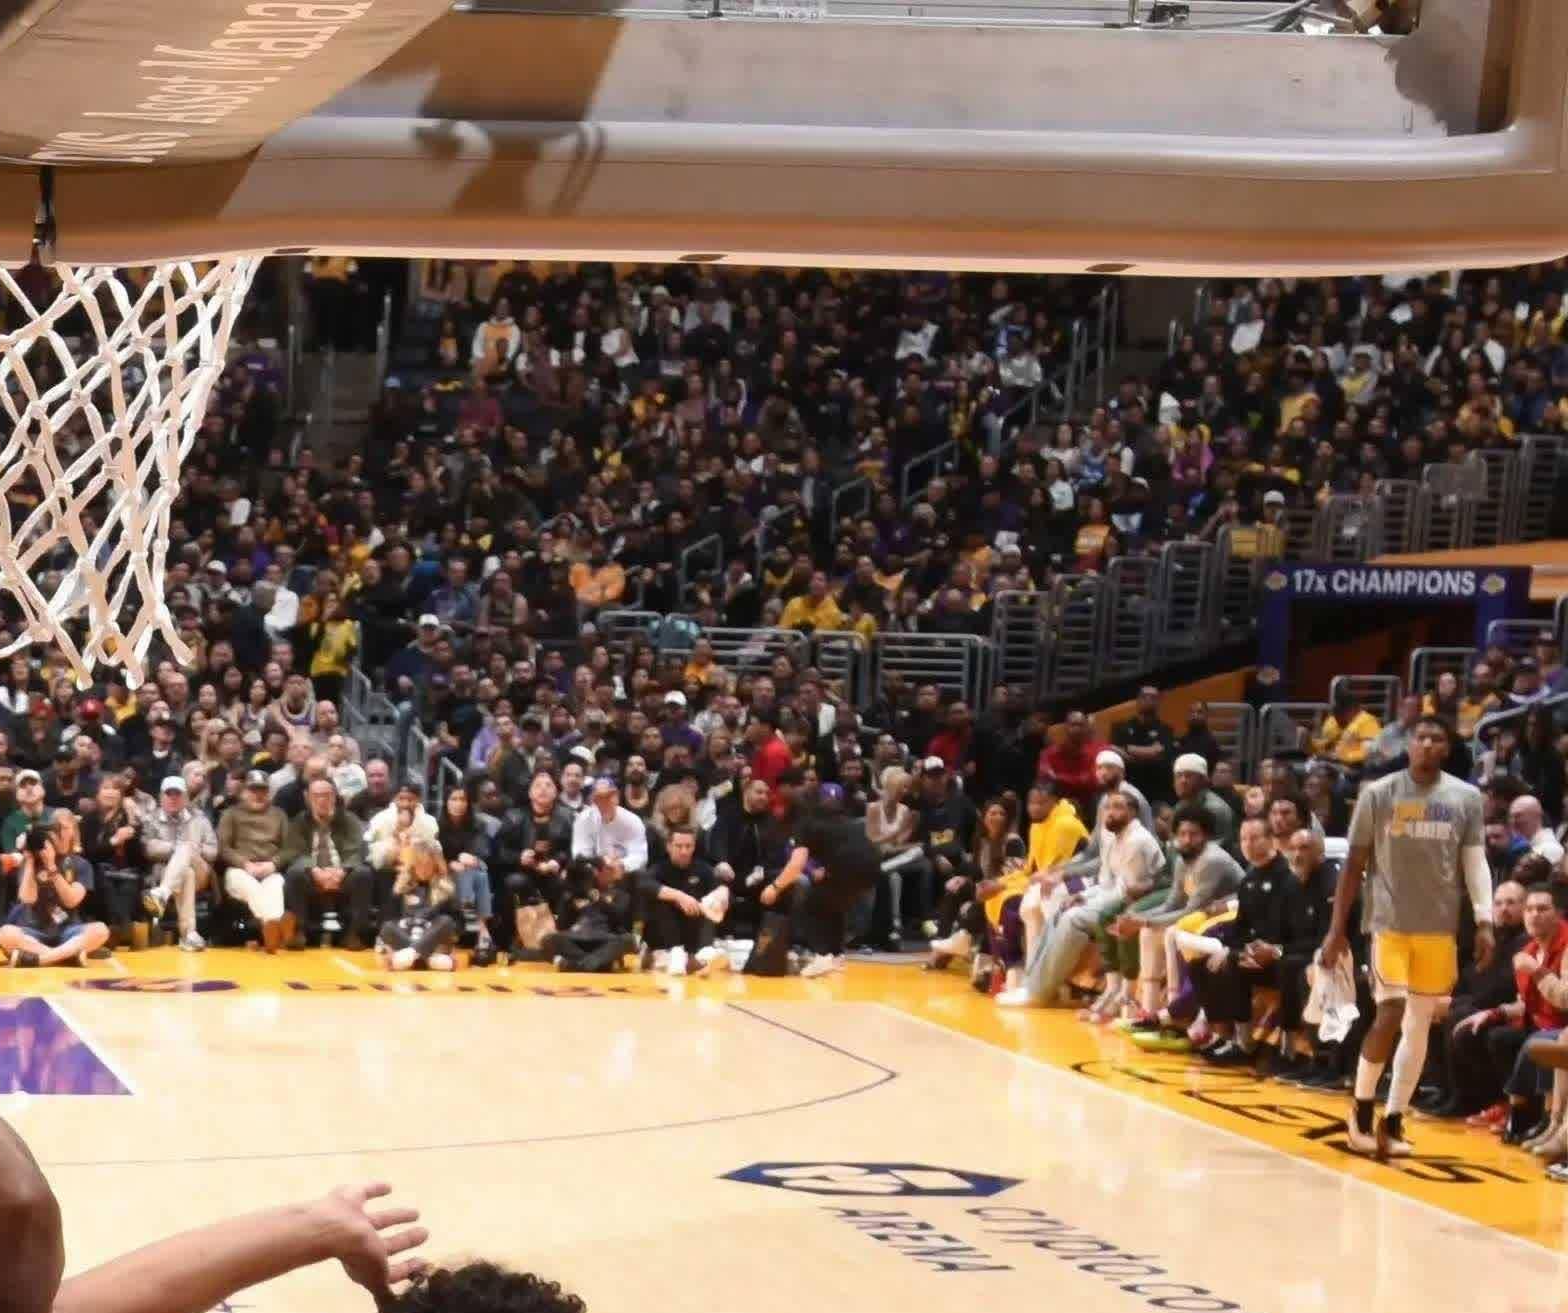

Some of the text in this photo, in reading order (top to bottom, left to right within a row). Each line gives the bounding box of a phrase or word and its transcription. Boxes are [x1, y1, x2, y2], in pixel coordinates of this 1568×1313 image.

[1293, 568, 1477, 596] 17x CHAMPIONS
[819, 1205, 1016, 1273] ARENA
